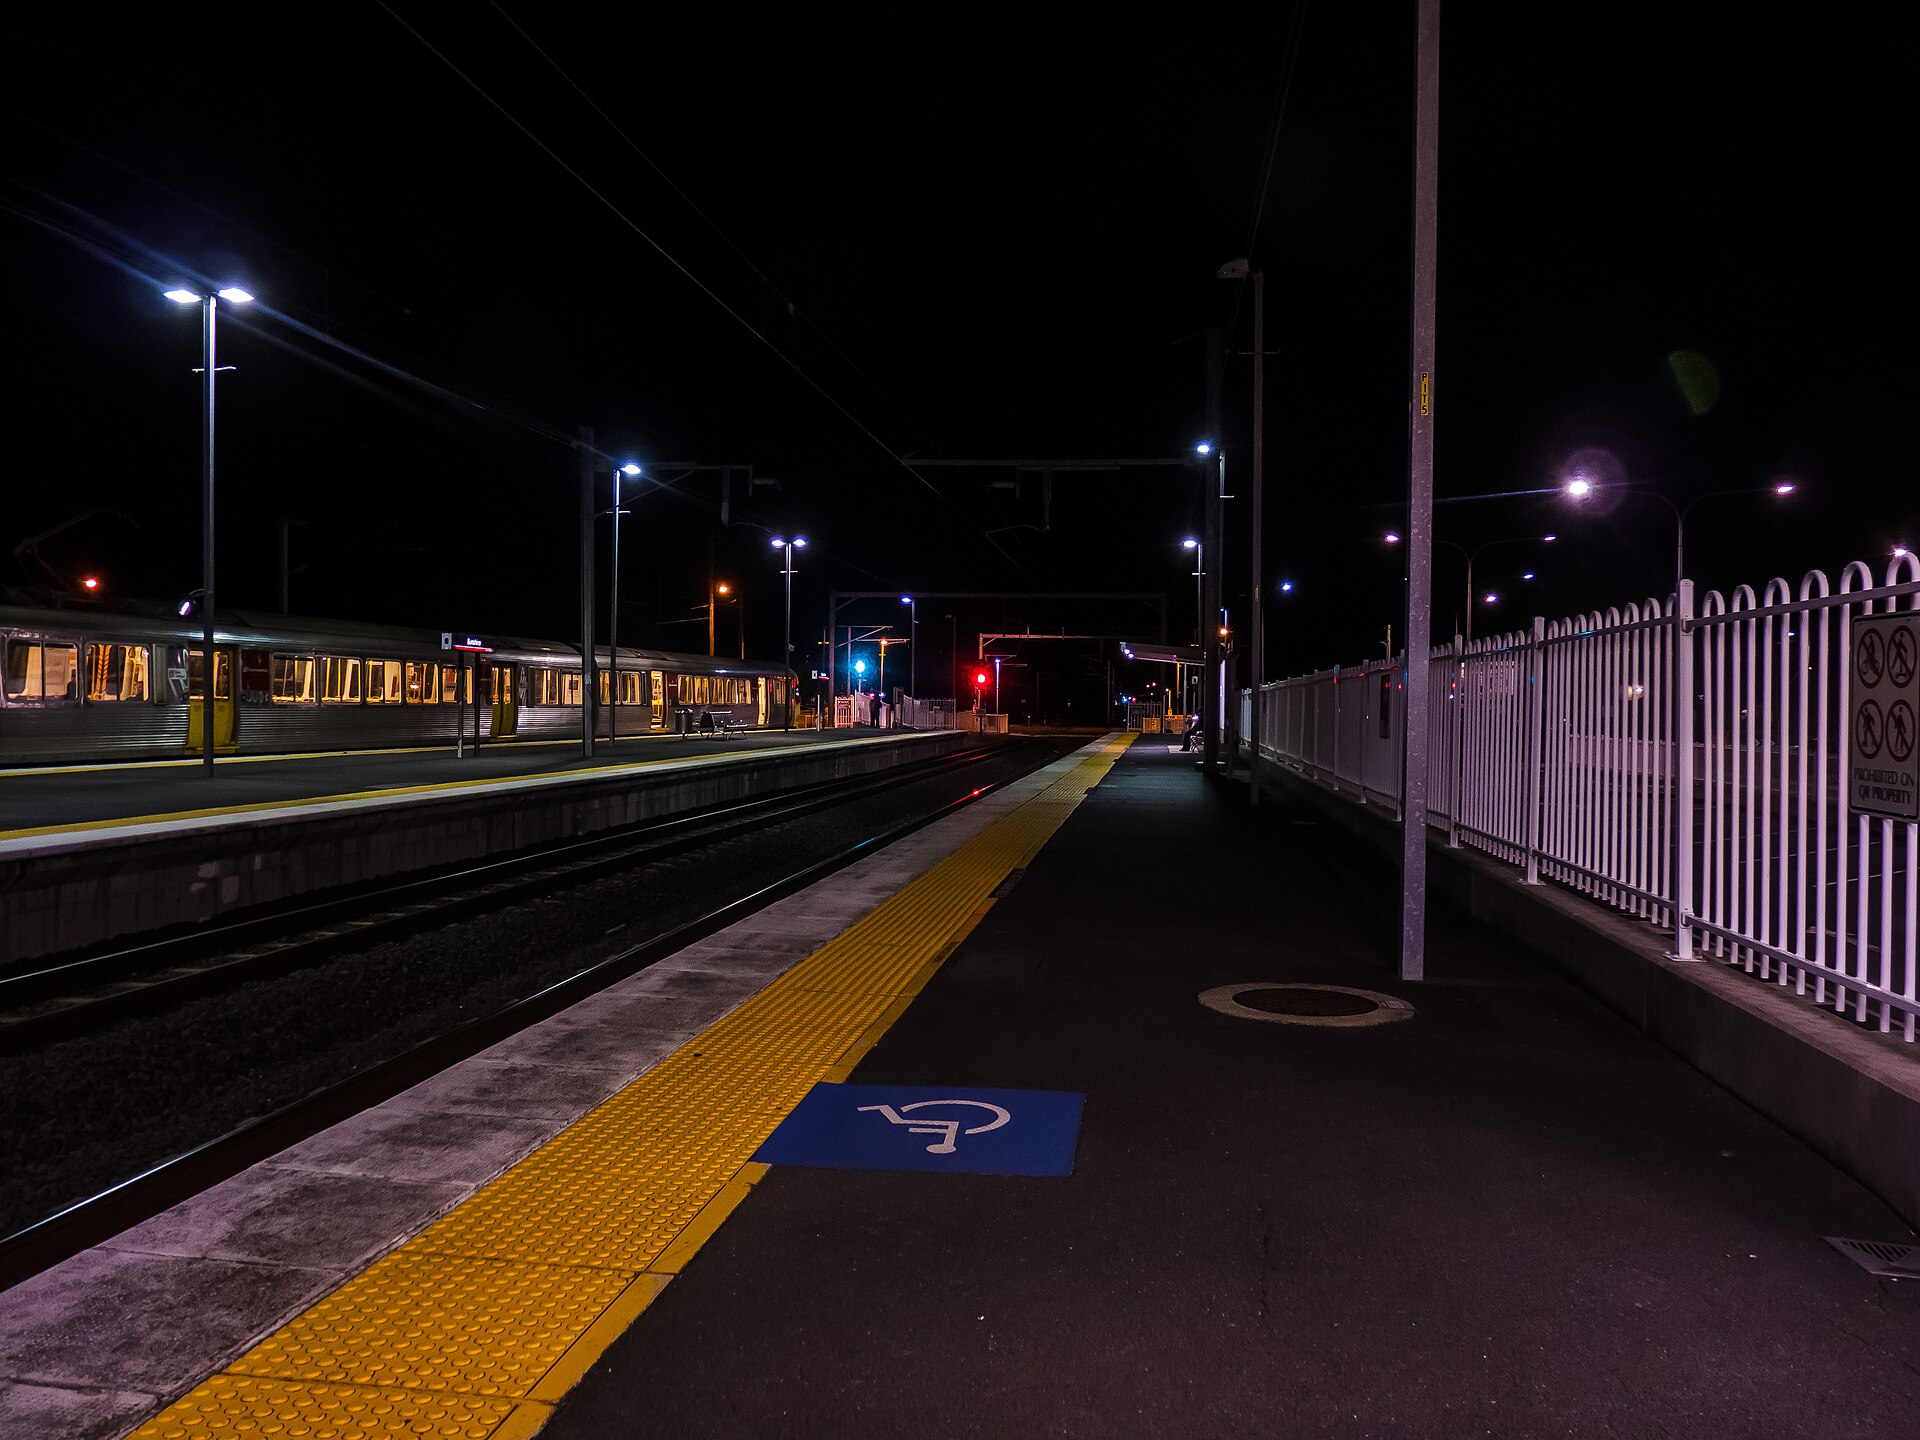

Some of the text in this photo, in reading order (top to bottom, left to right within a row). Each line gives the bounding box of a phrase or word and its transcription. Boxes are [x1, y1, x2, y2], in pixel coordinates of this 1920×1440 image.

[1854, 767, 1914, 786] PROHIBITED ON
[1872, 786, 1910, 804] PROPERTY
